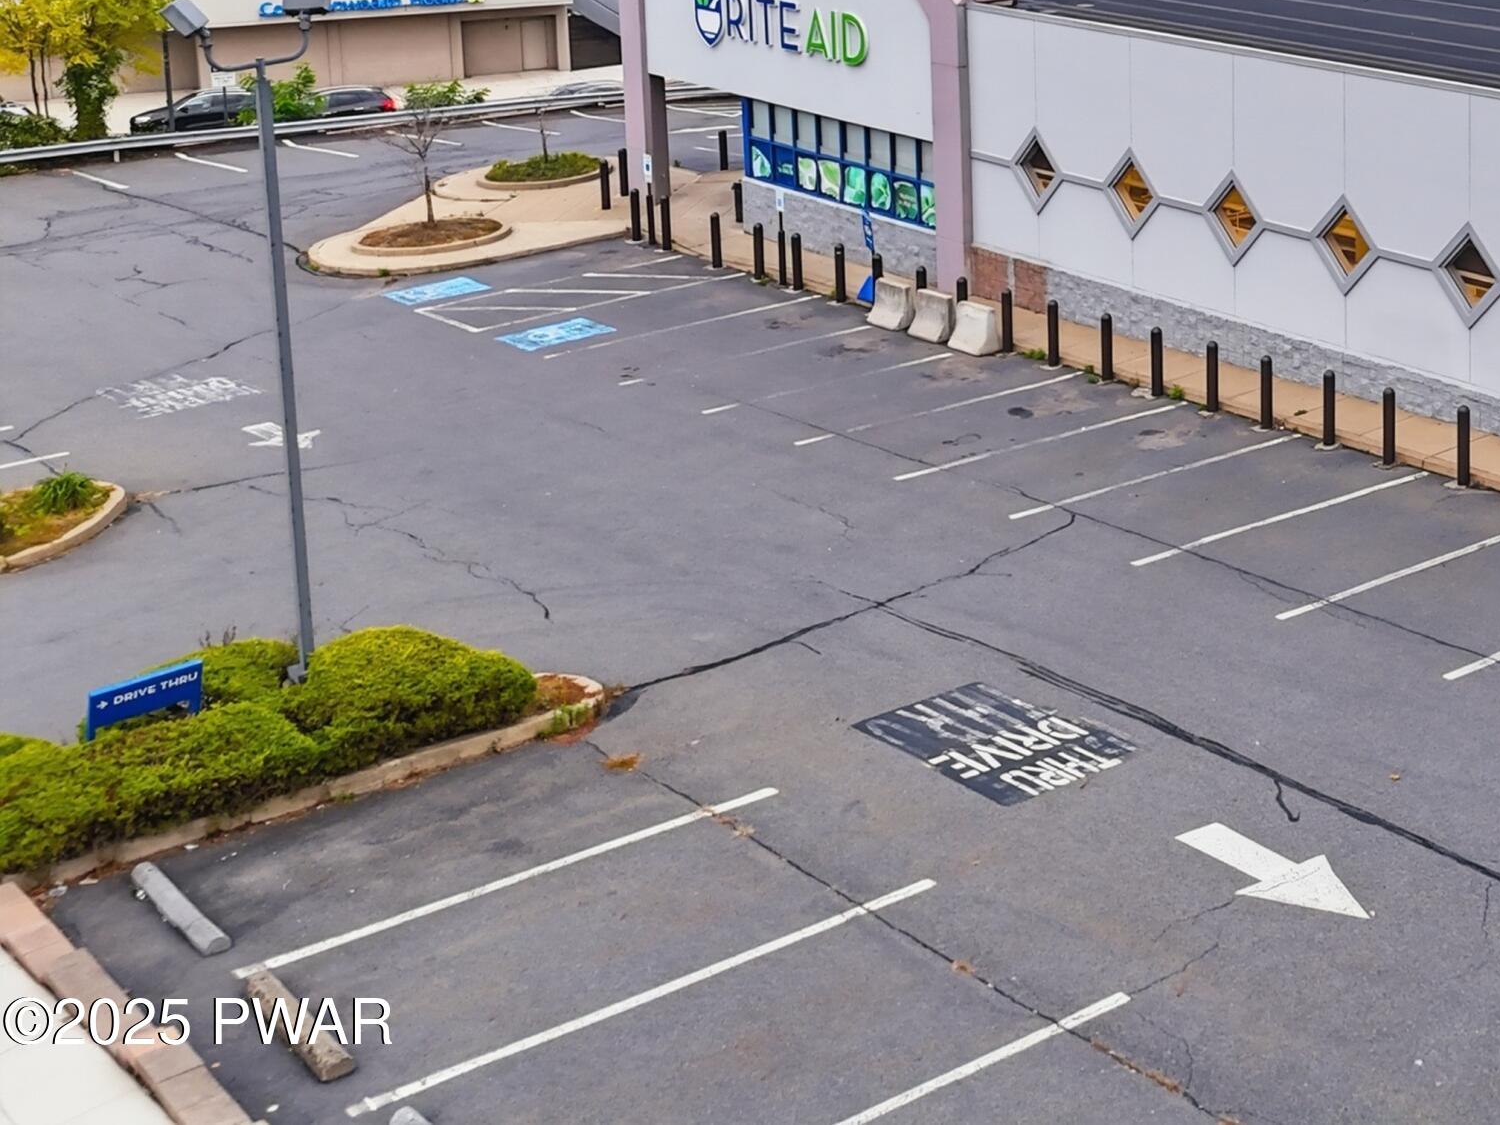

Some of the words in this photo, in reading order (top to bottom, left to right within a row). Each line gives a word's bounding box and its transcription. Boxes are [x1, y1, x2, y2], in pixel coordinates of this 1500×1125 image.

[806, 8, 867, 66] AID
[113, 684, 157, 705] DRIVE
[160, 671, 198, 690] THRU
[928, 715, 1090, 779] DRIVE
[1000, 744, 1123, 796] THRU
